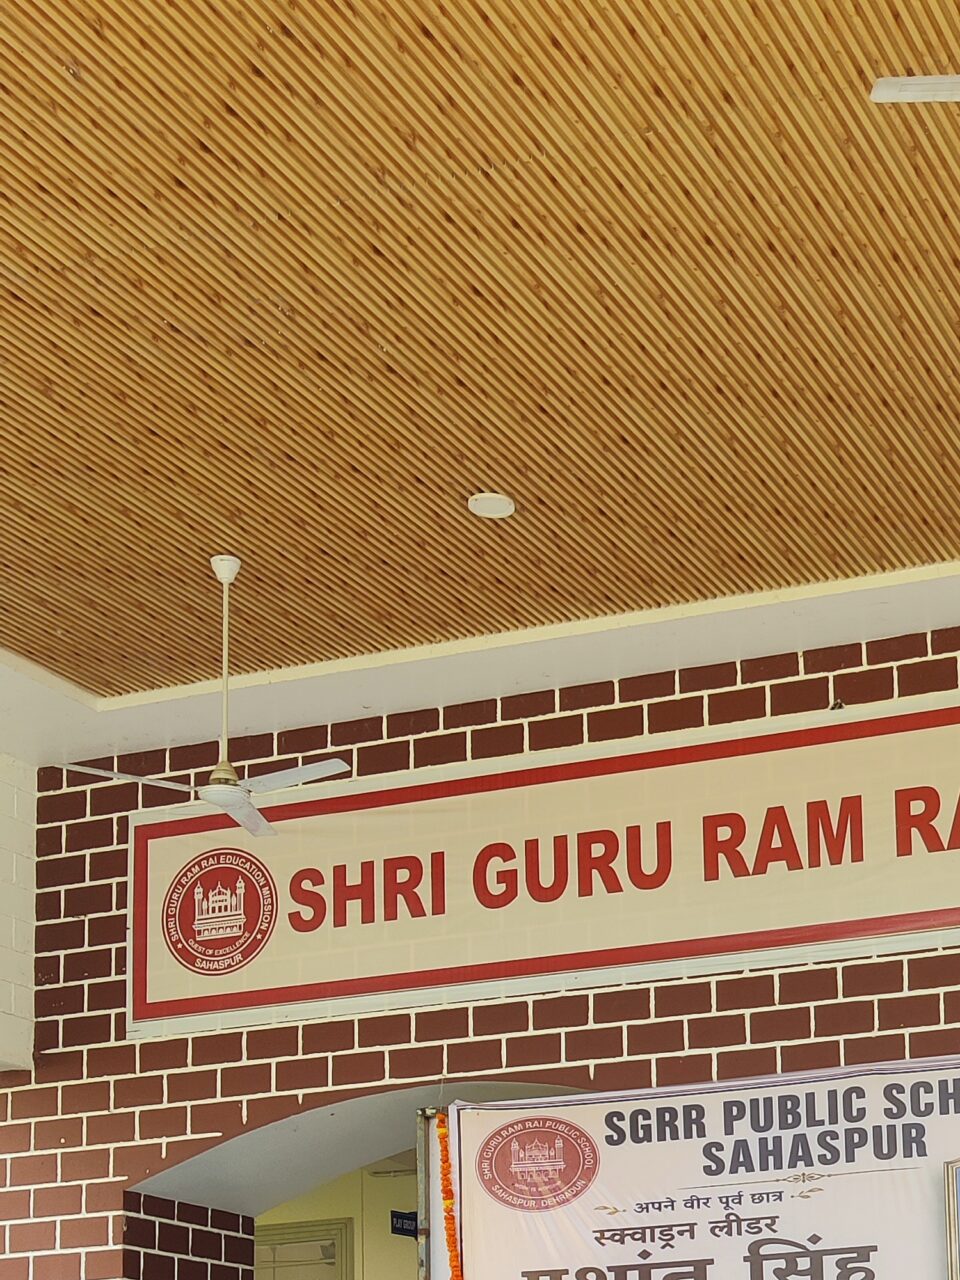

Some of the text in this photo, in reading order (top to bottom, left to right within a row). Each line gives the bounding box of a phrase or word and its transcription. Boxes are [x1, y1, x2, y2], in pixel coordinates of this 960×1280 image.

[287, 851, 446, 933] SHRI
[473, 820, 673, 910] GURU
[702, 795, 864, 882] RAM
[168, 855, 272, 942] SHRI GURU RAM RAI EDUCATION MISSION
[195, 953, 244, 970] SAHASPUR
[604, 1104, 707, 1147] SGRR
[722, 1086, 867, 1136] PUBLIC
[482, 1120, 594, 1180] SHRI GURU RAM RAI PUBLIC SCHOOL
[702, 1123, 928, 1177] SAHASPUR
[541, 1179, 586, 1207] DEHRADUN
[634, 1190, 784, 1214] अपने वीर पूर्व छात्र
[593, 1212, 780, 1249] स्क्वाड्रन लीडर
